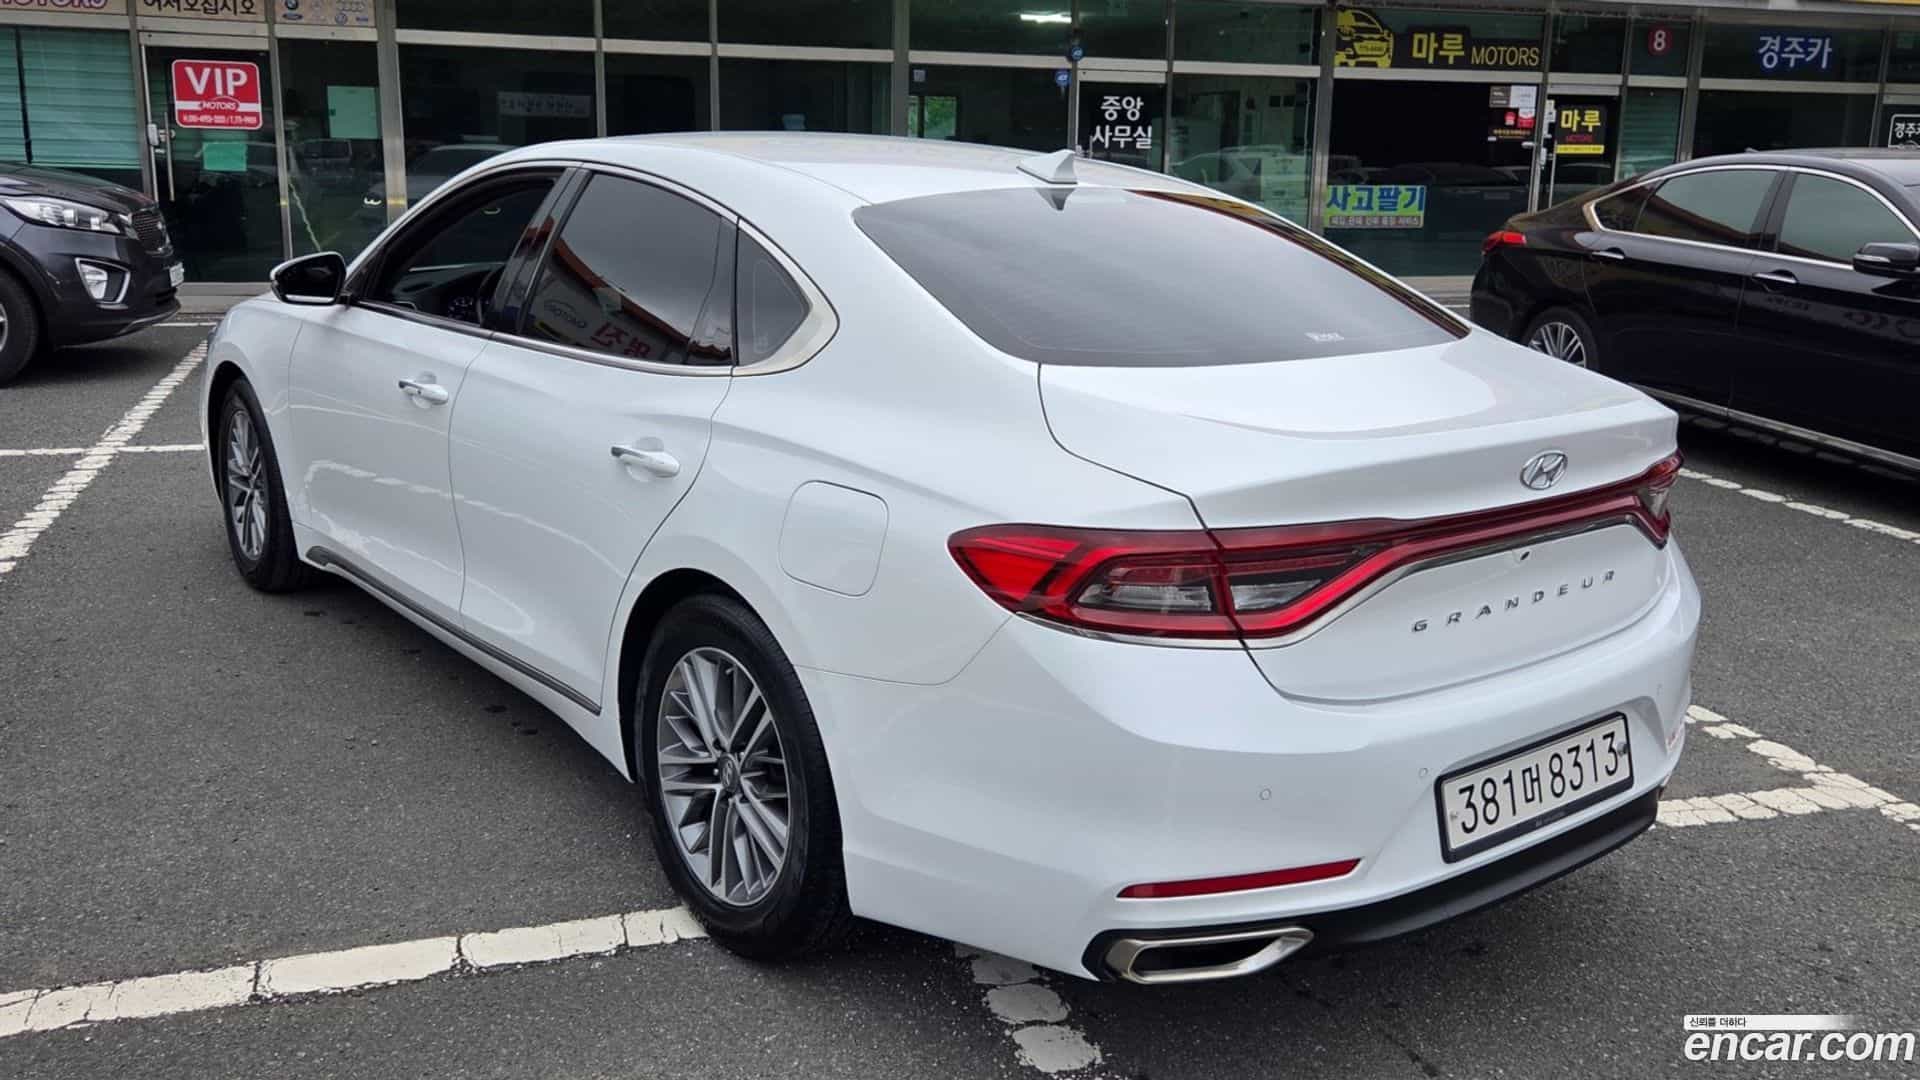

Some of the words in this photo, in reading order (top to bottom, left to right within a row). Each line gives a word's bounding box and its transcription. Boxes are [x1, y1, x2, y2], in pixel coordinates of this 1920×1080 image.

[1412, 32, 1465, 64] 마루
[1471, 46, 1540, 67] MOTORS
[1653, 30, 1666, 51] 8
[1758, 36, 1833, 69] 경주카
[184, 66, 248, 96] VIP
[201, 101, 237, 110] MOTORS
[1100, 96, 1144, 121] 중앙
[1561, 109, 1601, 132] 마루
[1092, 125, 1153, 149] 사무실
[1327, 186, 1425, 211] 사고팔기
[1412, 570, 1614, 632] GRANDEUR
